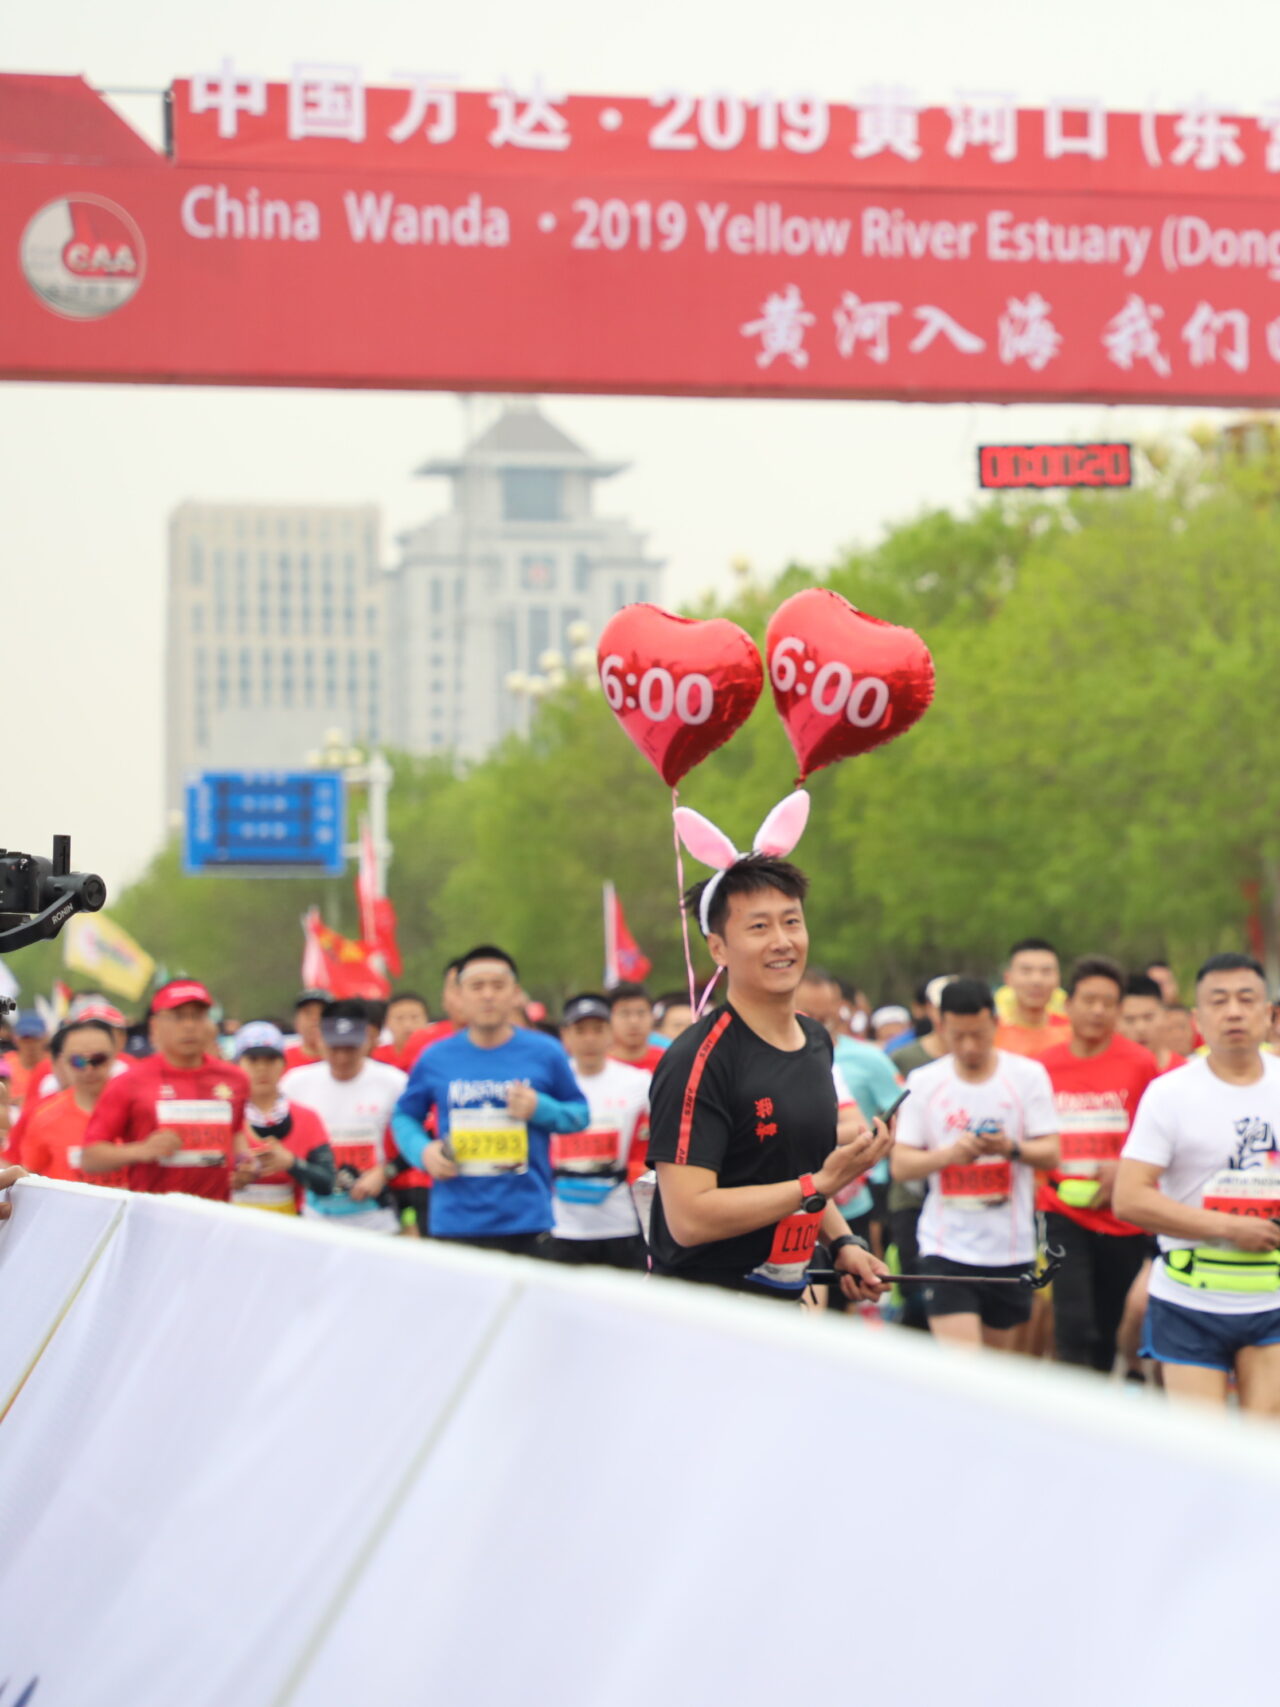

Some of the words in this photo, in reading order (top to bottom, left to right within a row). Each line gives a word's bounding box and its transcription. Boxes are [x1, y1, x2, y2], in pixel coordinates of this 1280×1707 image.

[181, 186, 320, 242] China
[346, 192, 509, 247] Wanda
[572, 198, 687, 252] 2019
[698, 202, 850, 256] Yellow
[862, 207, 977, 260] River
[986, 210, 1152, 276] Estuary
[741, 284, 1062, 371] 黄河入海
[600, 654, 714, 725] 6:00
[771, 636, 889, 728] 6:00
[51, 902, 74, 925] RONIN
